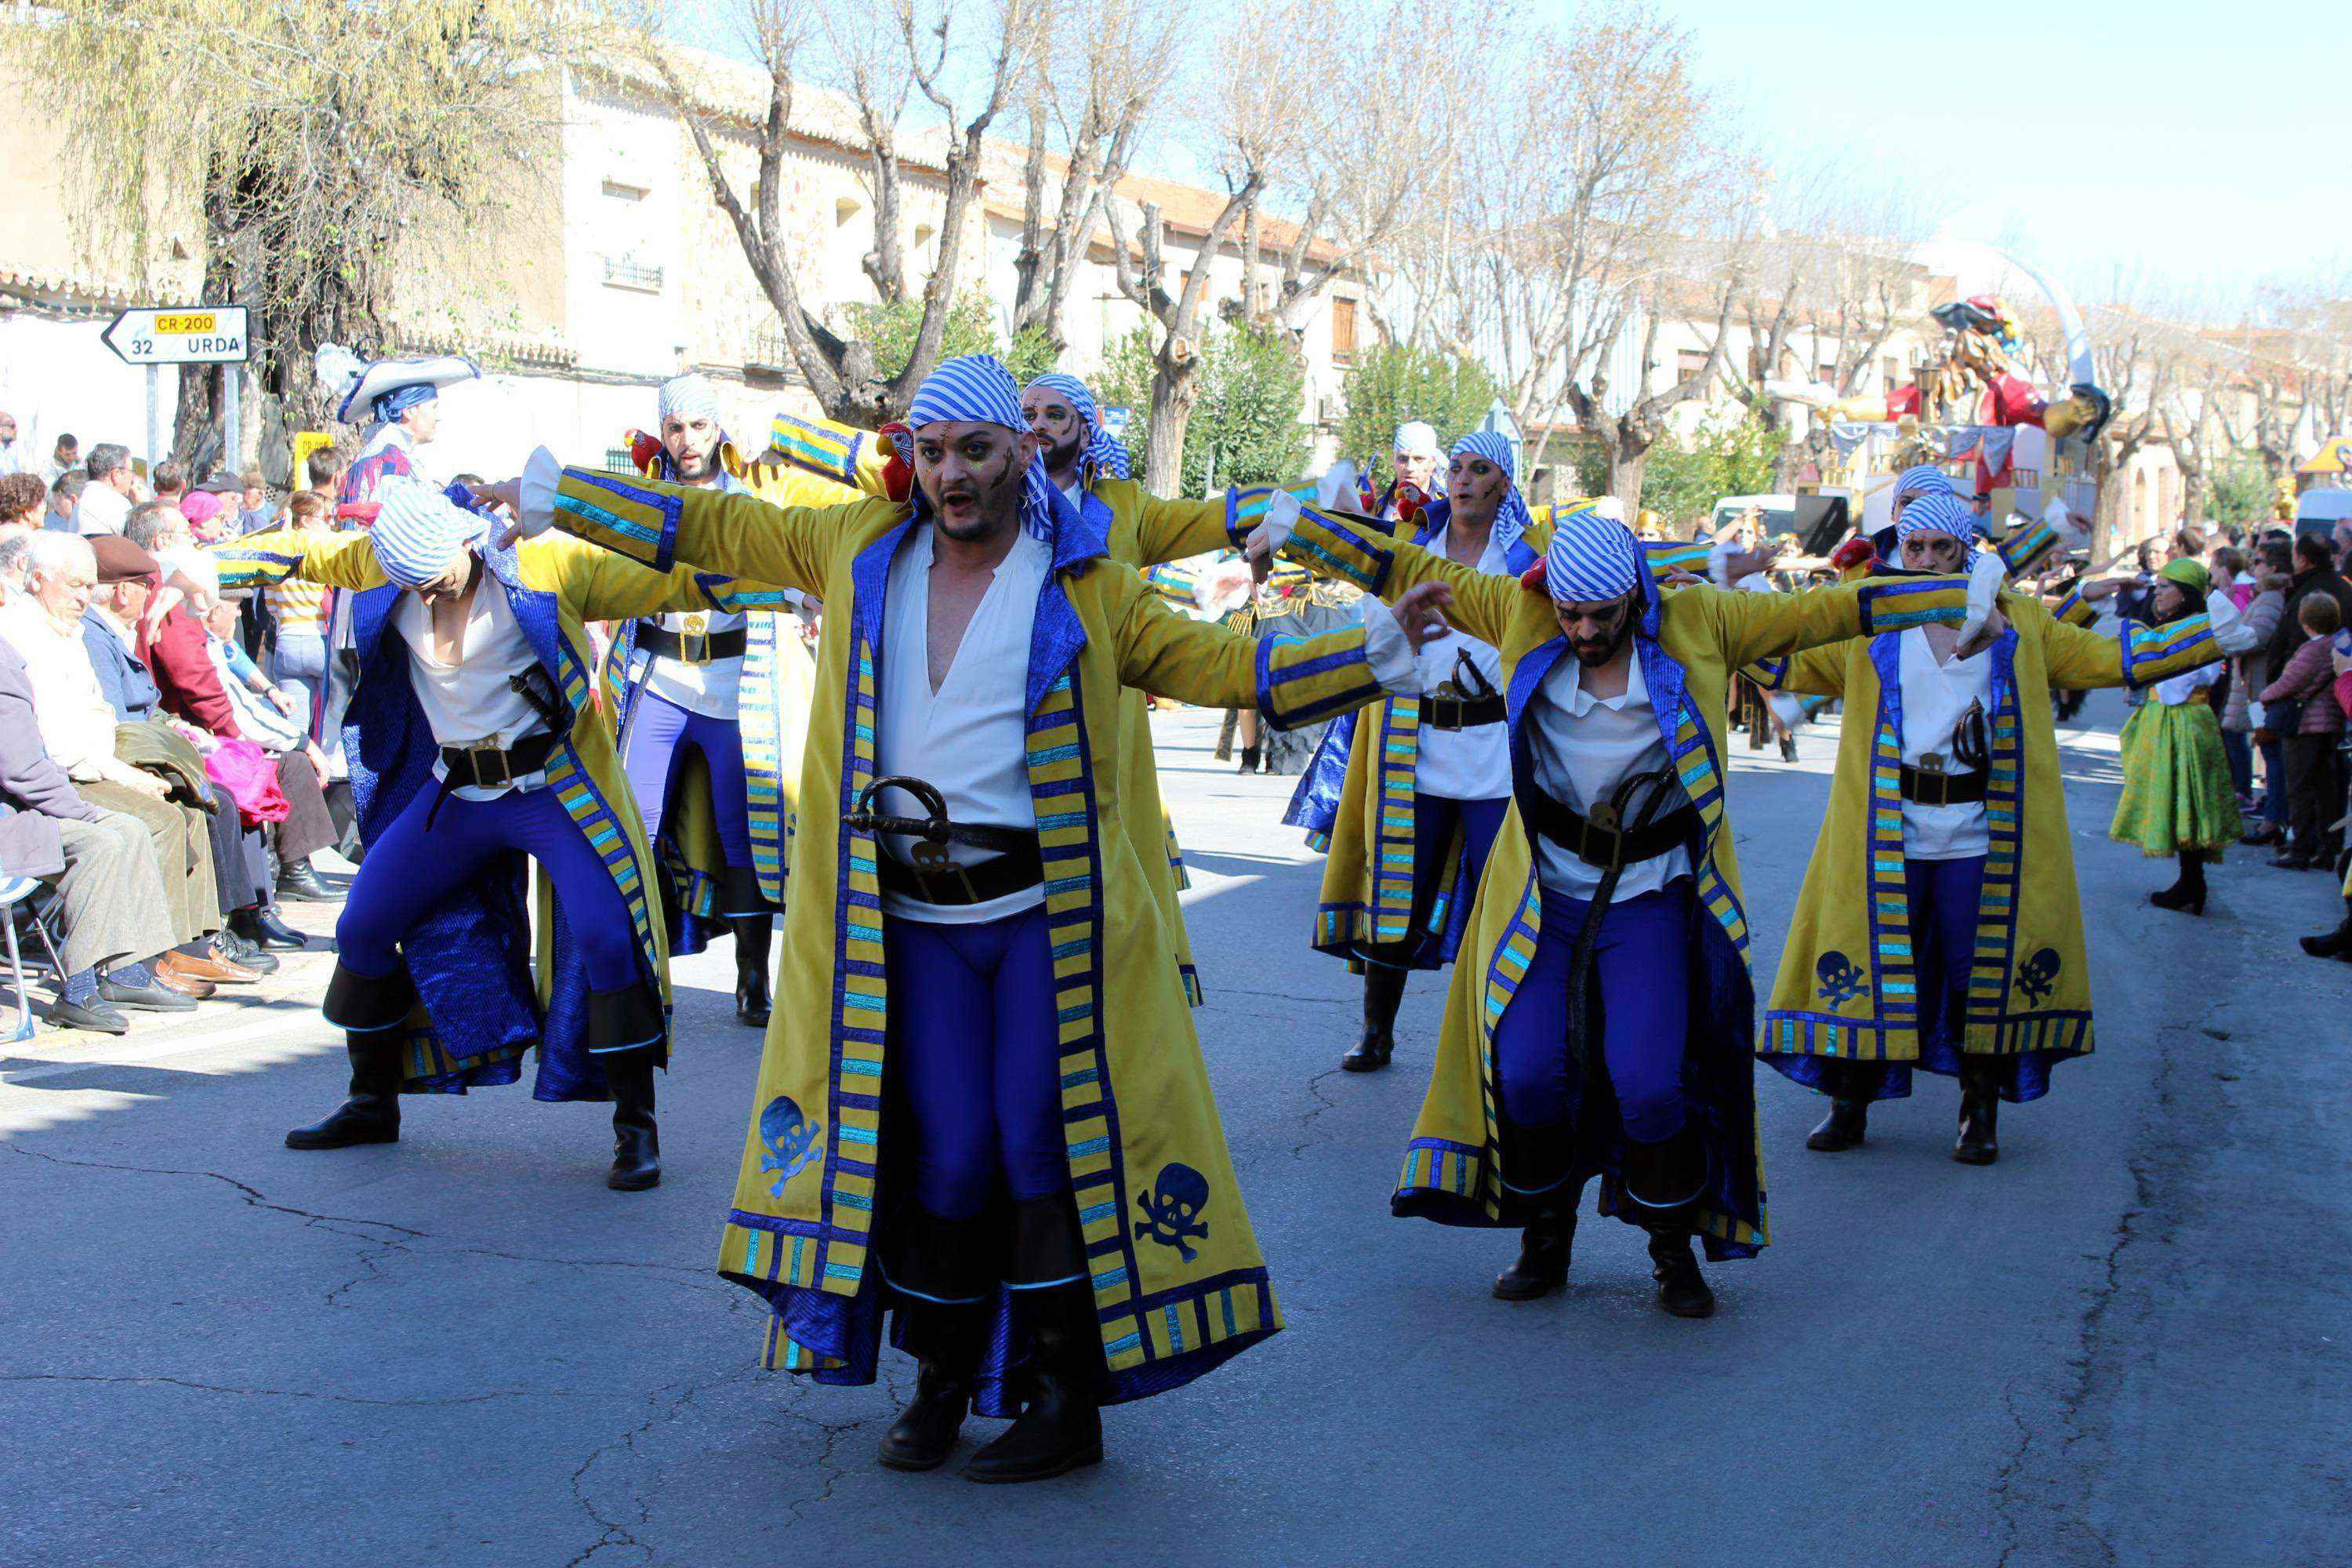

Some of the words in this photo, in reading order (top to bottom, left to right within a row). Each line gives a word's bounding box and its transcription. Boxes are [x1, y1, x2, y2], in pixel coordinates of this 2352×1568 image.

[158, 318, 212, 330] CR-200
[132, 340, 153, 354] 32
[188, 338, 239, 353] URDA
